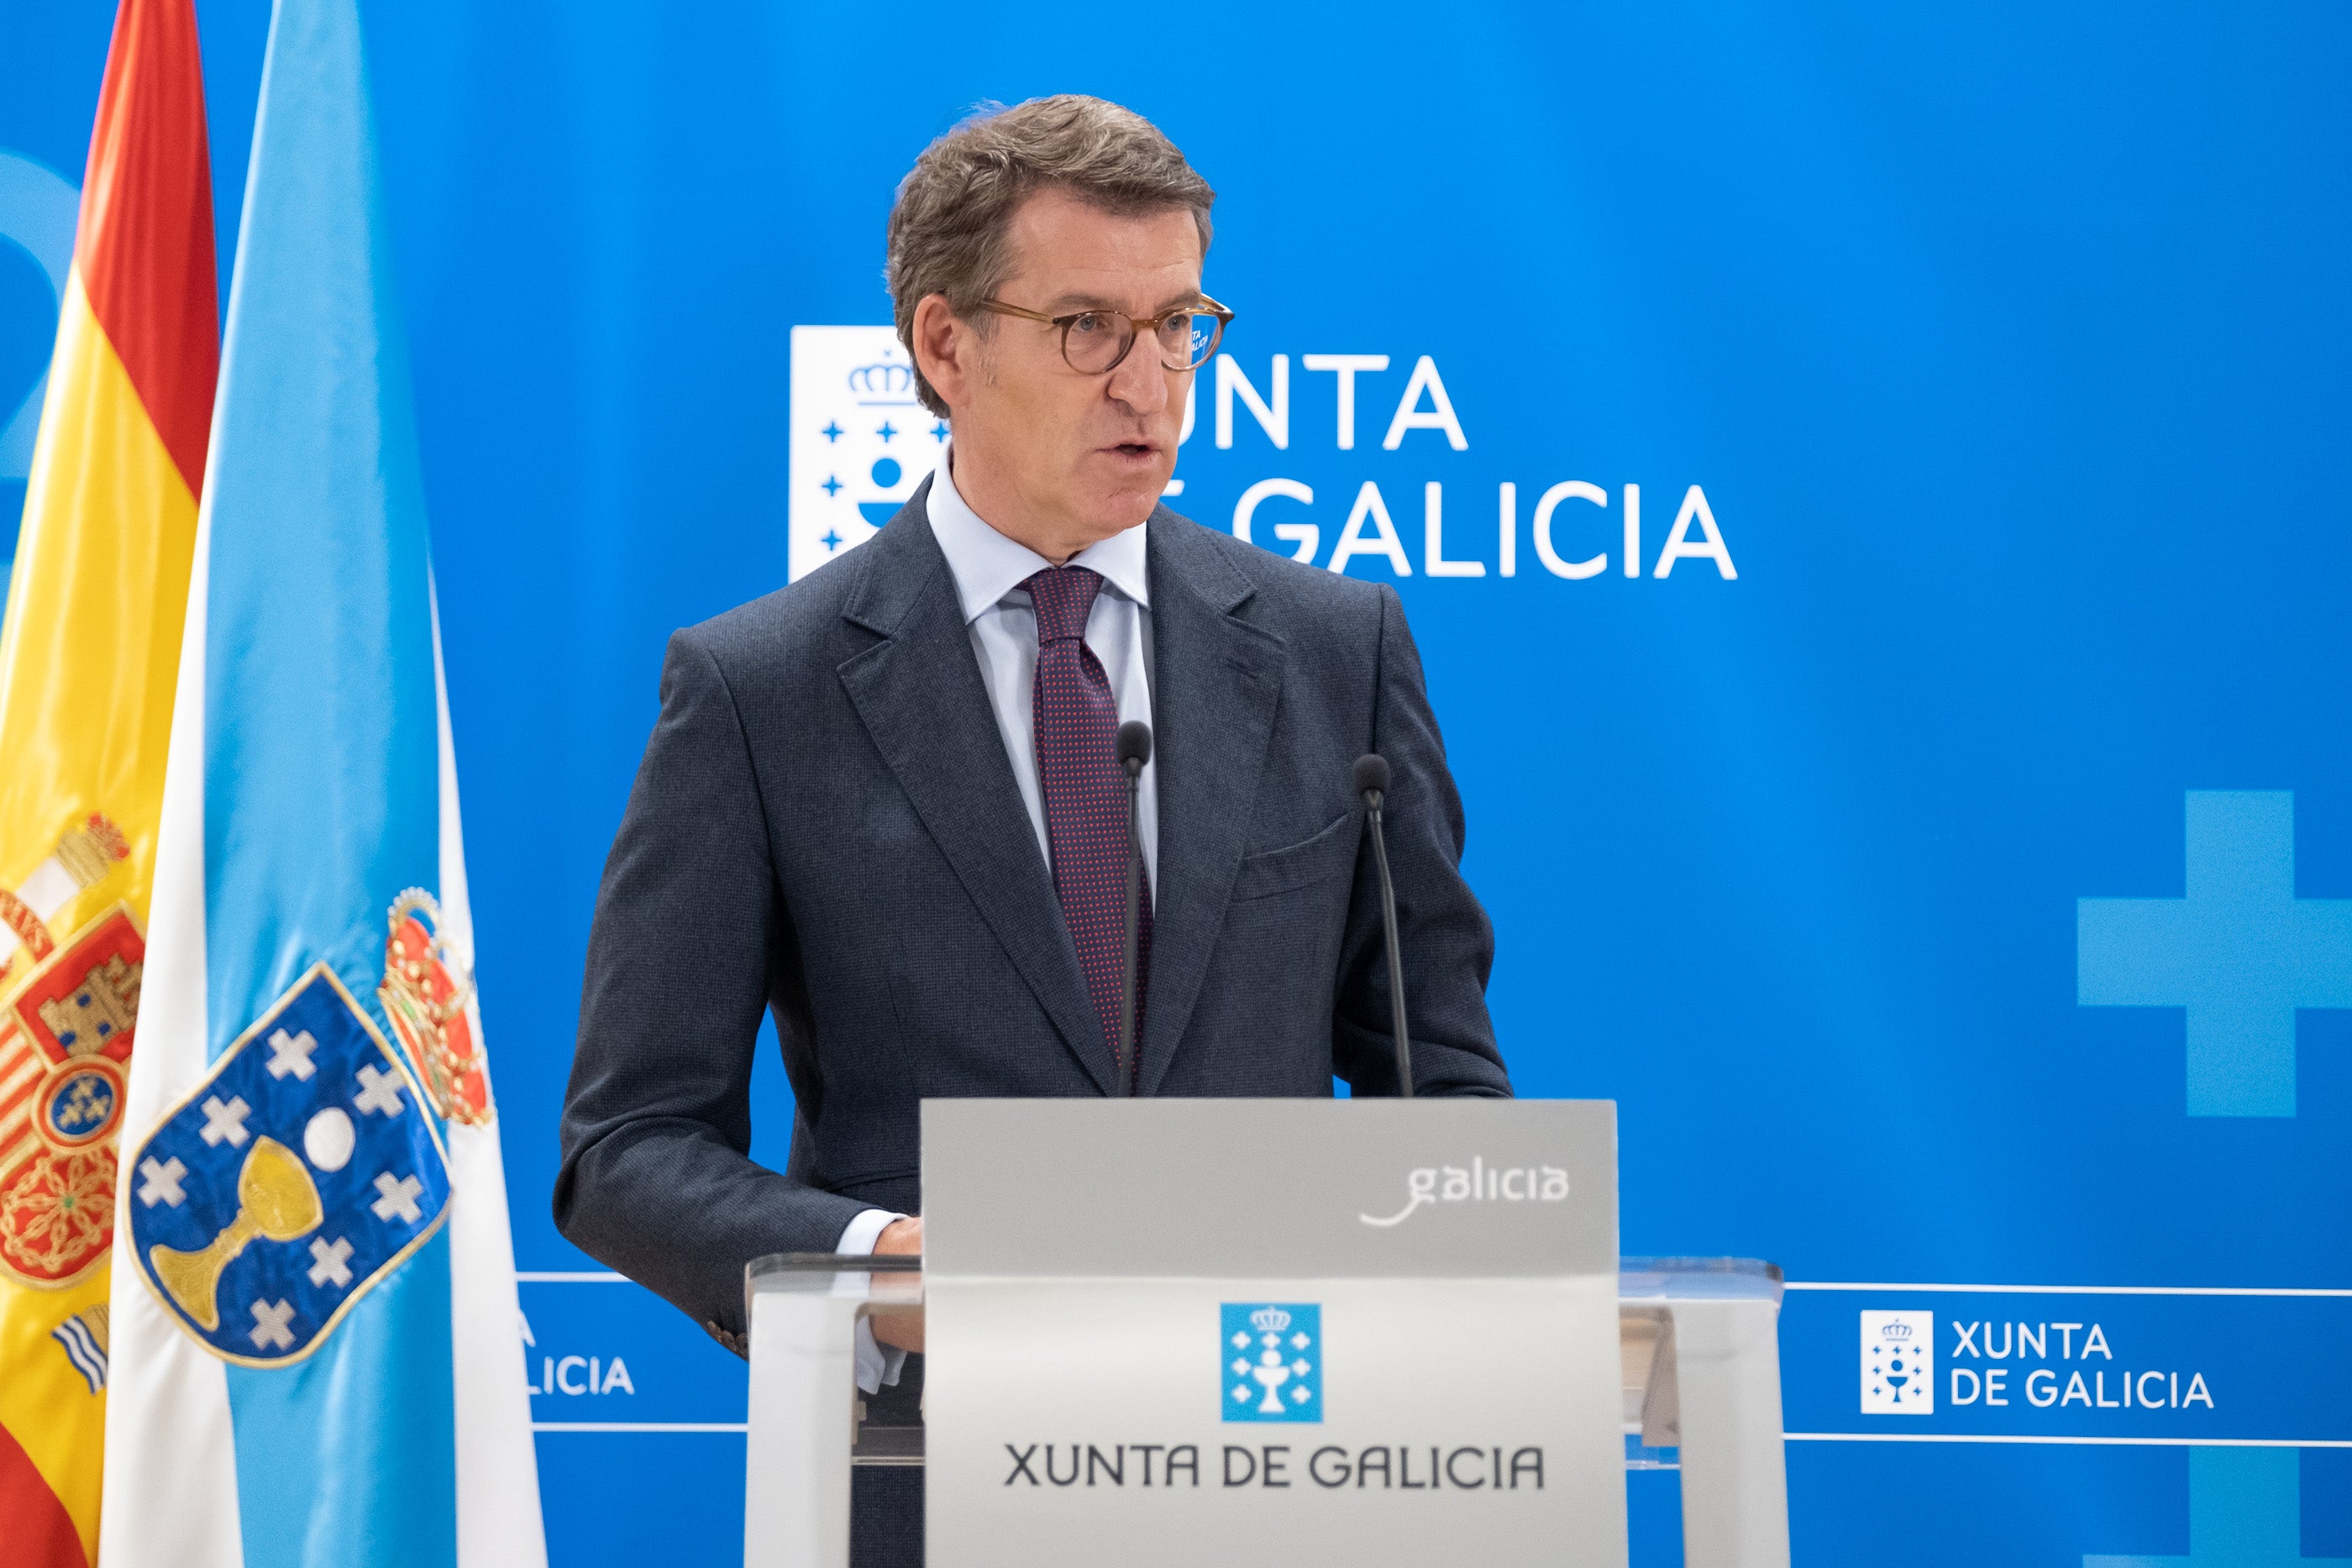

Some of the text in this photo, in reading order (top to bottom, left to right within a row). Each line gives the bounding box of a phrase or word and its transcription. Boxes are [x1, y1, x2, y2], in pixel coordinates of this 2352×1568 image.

[1231, 478, 1739, 580] GALICIA
[1360, 1155, 1569, 1227] galicia
[1950, 1320, 2113, 1361] XUNTA
[1950, 1368, 2215, 1409] DE GALICIA
[1004, 1444, 1546, 1490] XUNTA DE GALICIA
